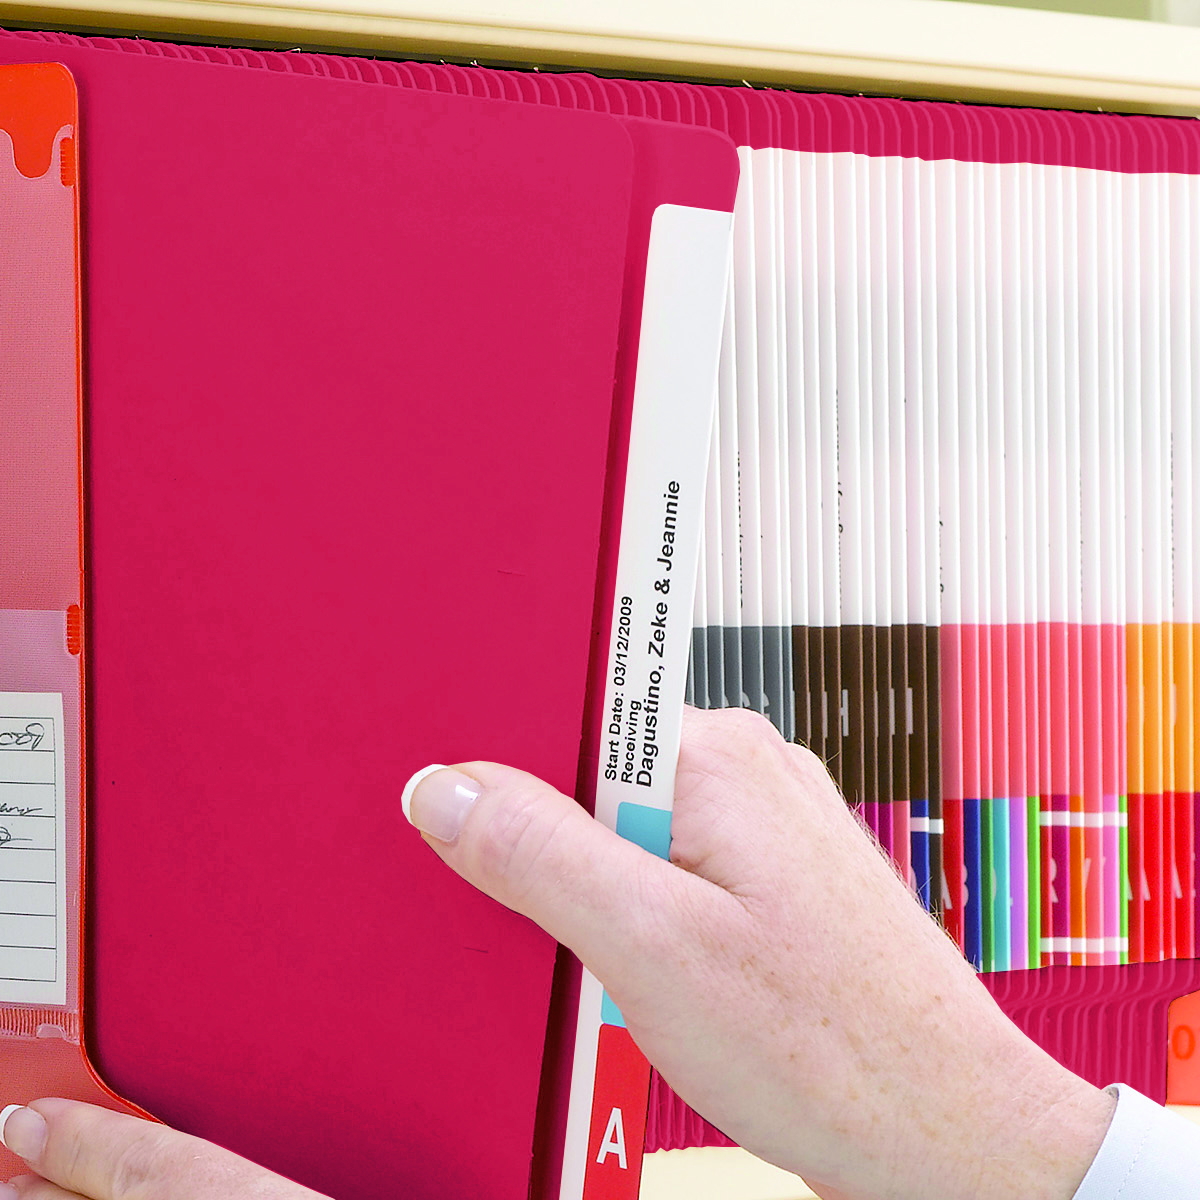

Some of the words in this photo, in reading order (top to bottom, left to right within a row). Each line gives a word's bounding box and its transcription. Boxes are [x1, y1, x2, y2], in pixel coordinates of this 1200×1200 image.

[657, 481, 680, 571] Jeannie
[654, 579, 670, 594] &
[613, 596, 633, 686] 03/12/2009
[648, 602, 668, 657] Zeke
[609, 692, 625, 735] Date:
[621, 700, 641, 784] Receiving
[636, 665, 665, 787] Dagustino,
[605, 741, 619, 780] Start
[597, 1108, 628, 1169] A
